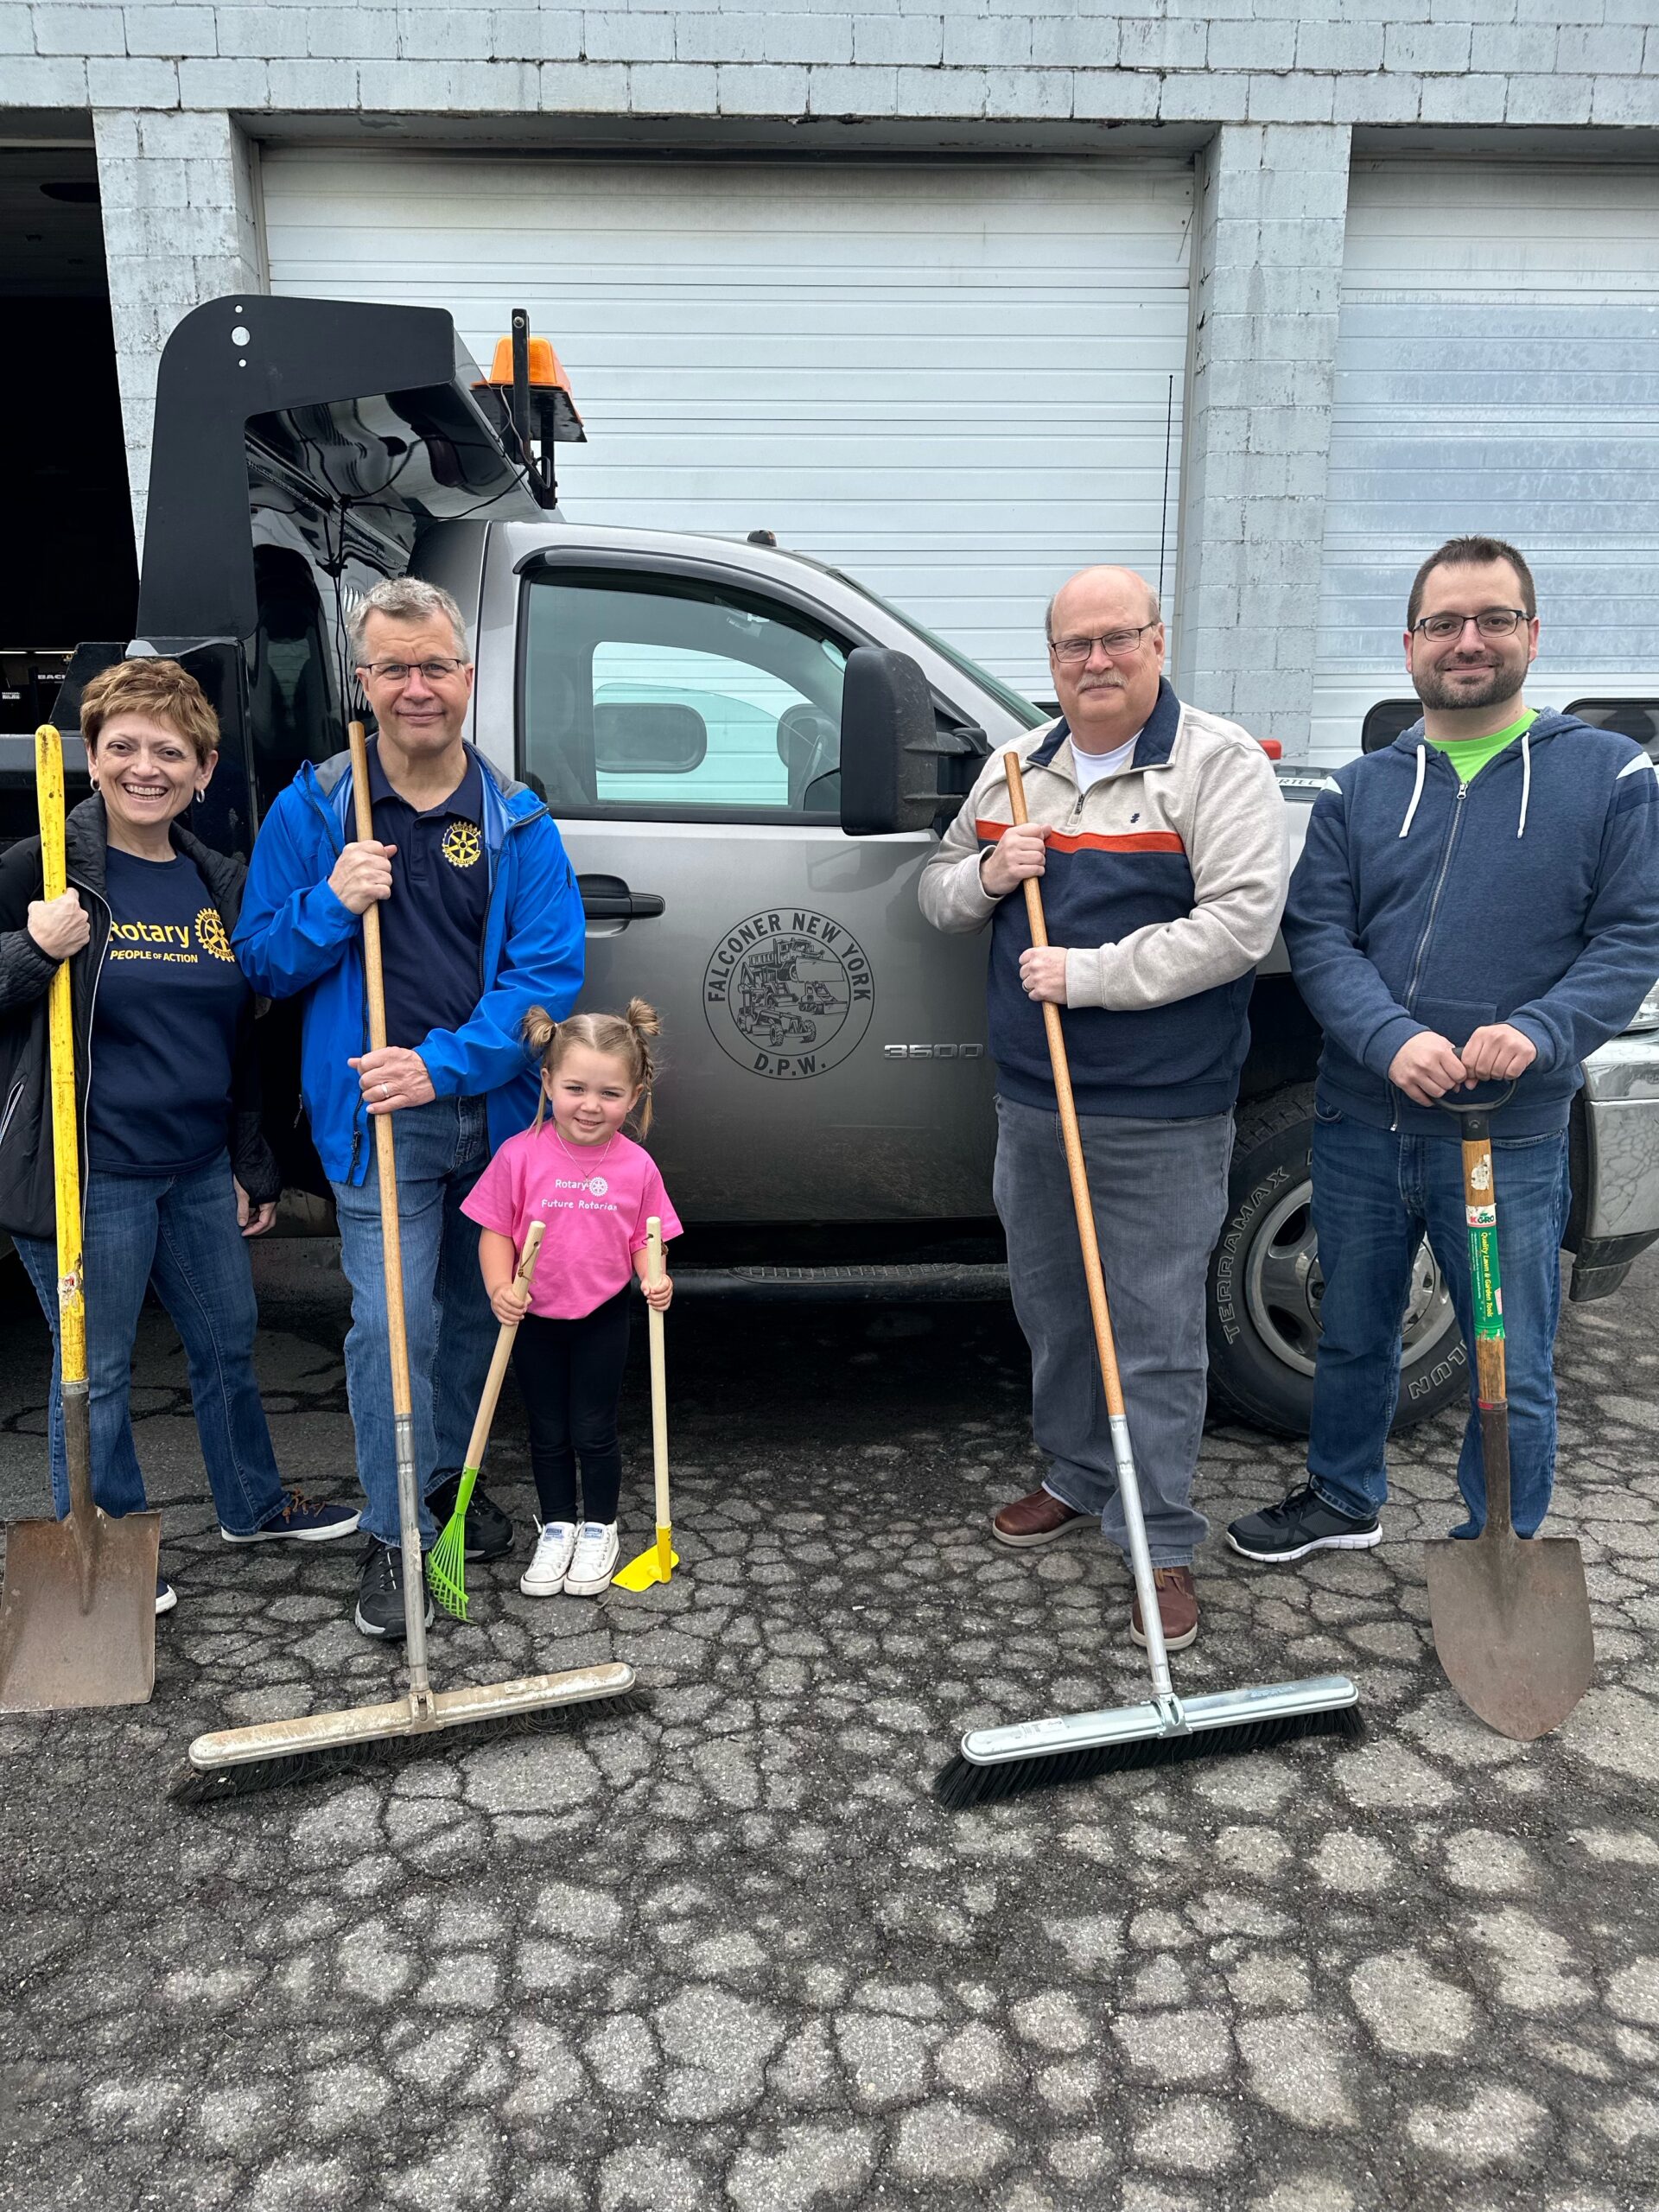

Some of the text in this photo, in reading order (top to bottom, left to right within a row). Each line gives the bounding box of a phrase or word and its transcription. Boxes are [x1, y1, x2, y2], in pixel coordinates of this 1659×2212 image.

[108, 920, 189, 949] Rotary
[109, 950, 152, 961] PEOPLE
[162, 952, 199, 963] ACTION
[708, 912, 871, 1002] FALCONER NEW YORK
[884, 1043, 983, 1058] 3500
[753, 1052, 826, 1076] D.P.W.
[555, 1179, 587, 1191] Rotary
[541, 1198, 618, 1211] Future Rotarian
[1480, 1232, 1490, 1254] Quality
[1217, 1166, 1290, 1344] TERRAMAX
